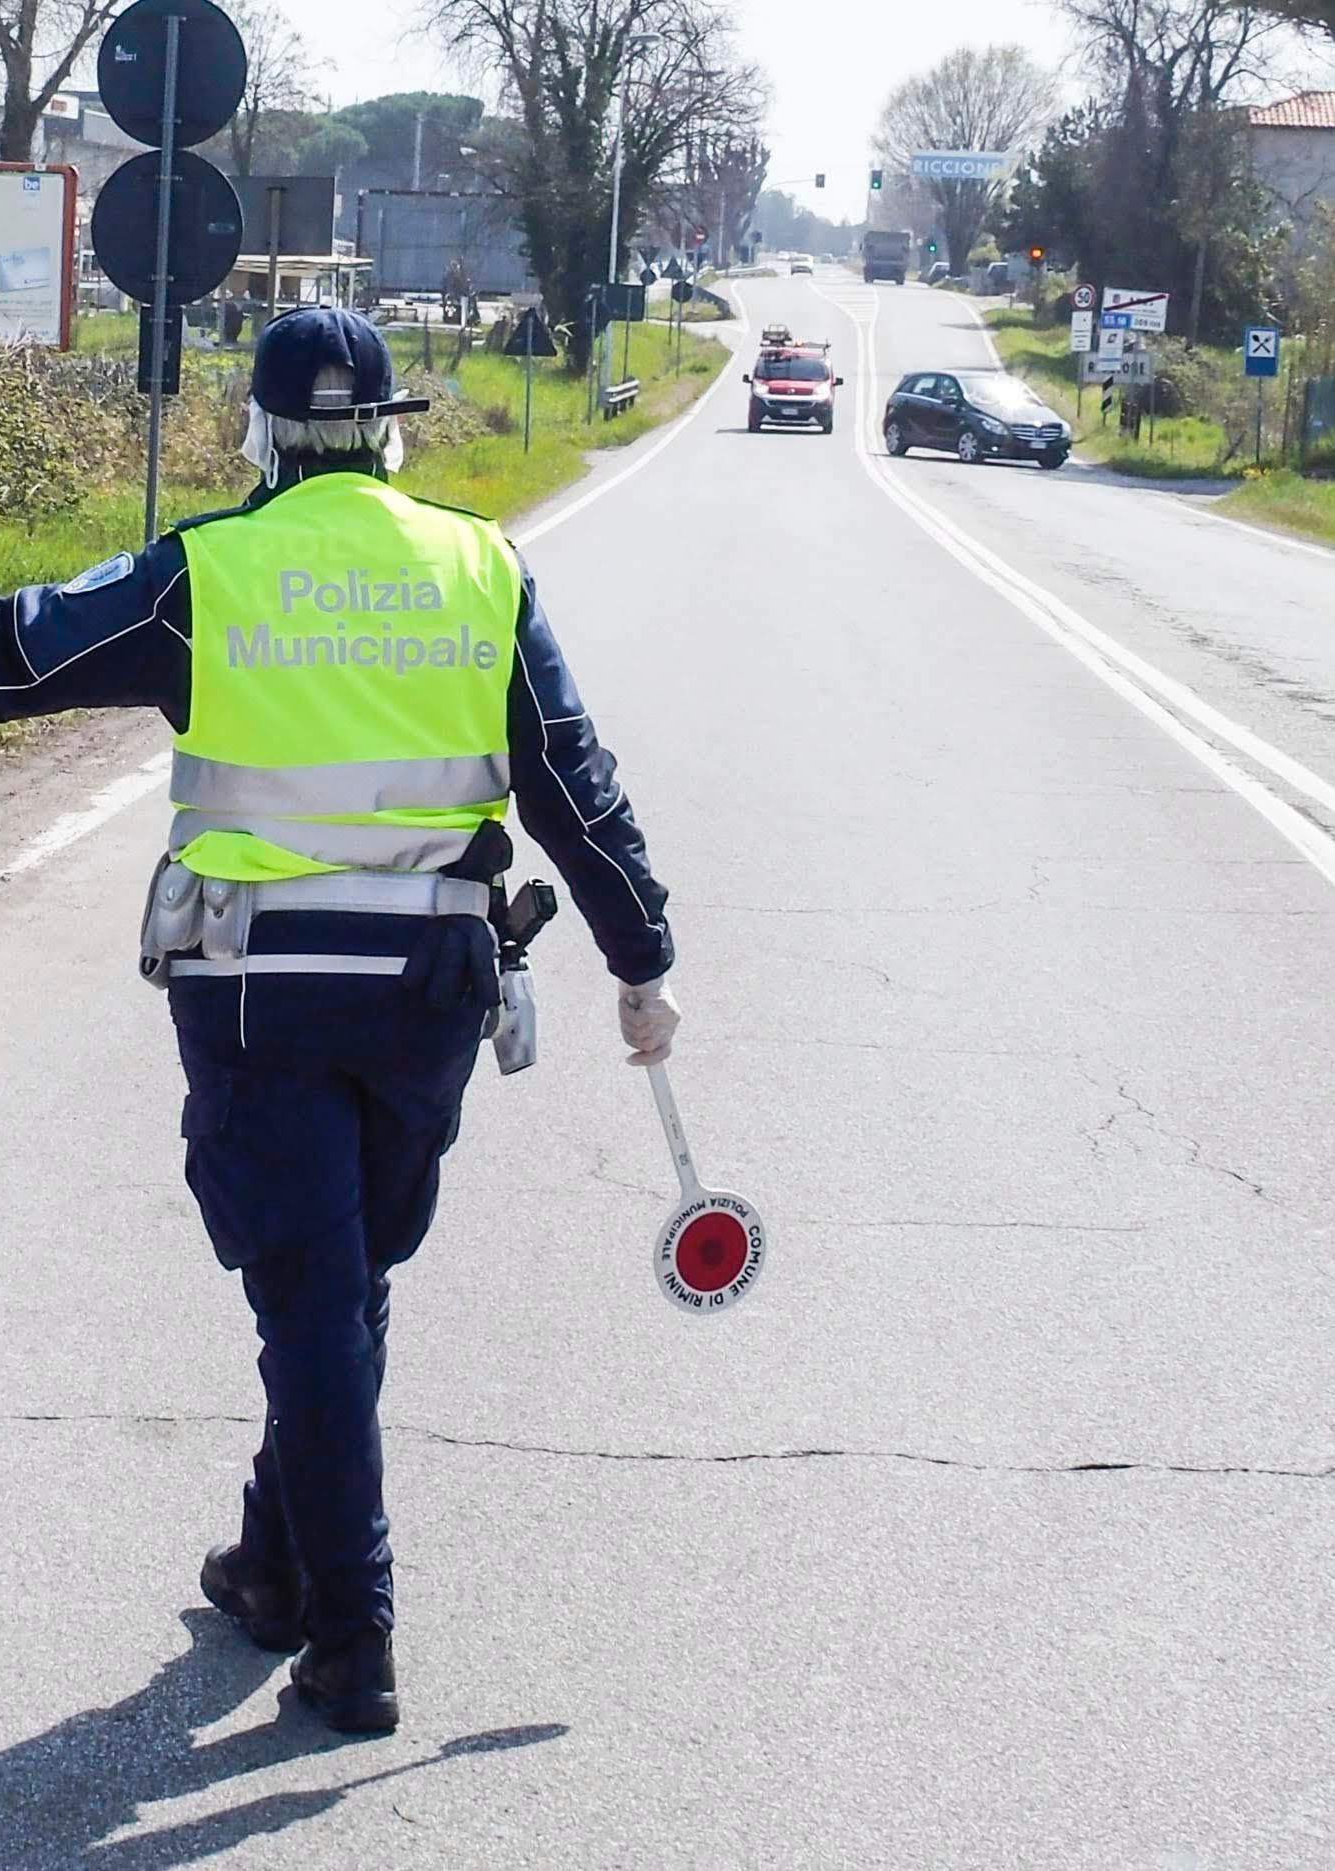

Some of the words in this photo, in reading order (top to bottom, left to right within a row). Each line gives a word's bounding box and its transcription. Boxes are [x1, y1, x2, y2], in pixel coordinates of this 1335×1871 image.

[1077, 291, 1090, 304] 50
[279, 568, 443, 613] Polizia
[226, 622, 498, 675] Municipale
[710, 1197, 749, 1218] POLIZIA
[661, 1200, 706, 1261] MUNICIPALE
[729, 1225, 762, 1297] COMUNE
[664, 1271, 704, 1307] RIMINI
[709, 1292, 724, 1307] DI
